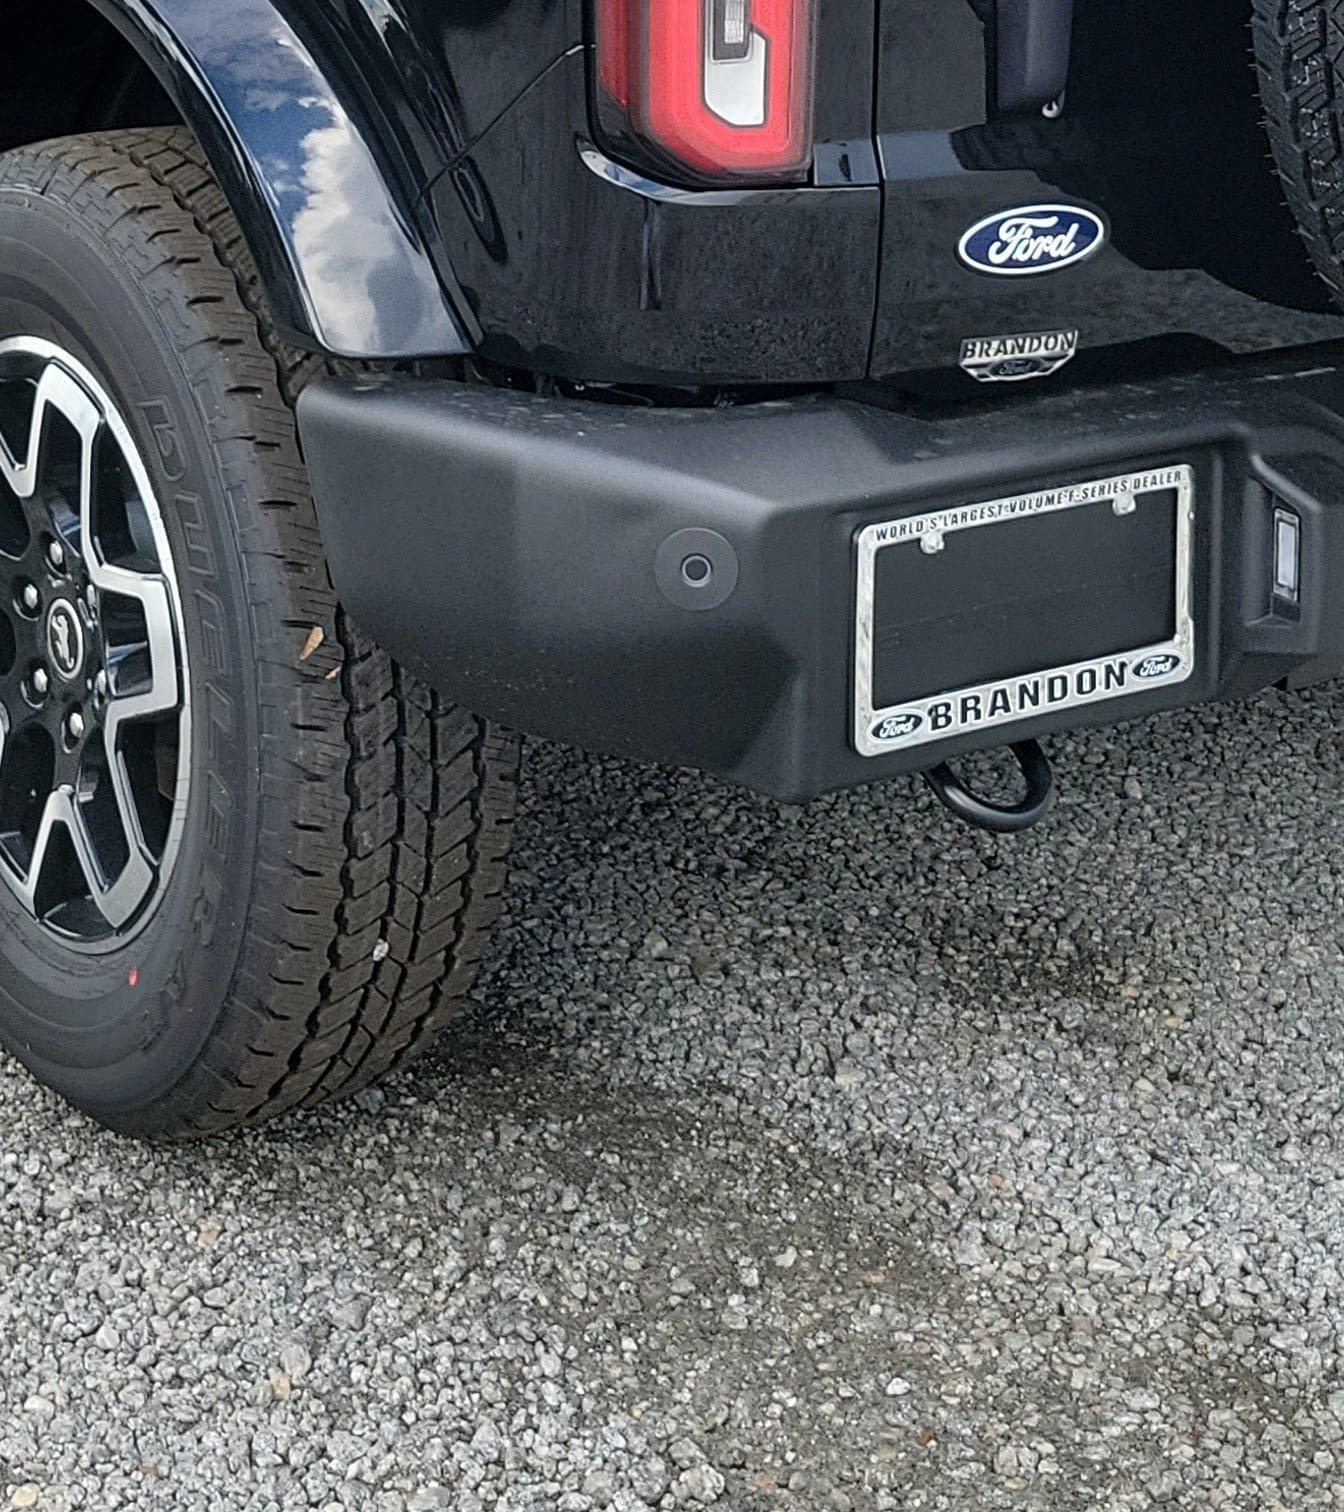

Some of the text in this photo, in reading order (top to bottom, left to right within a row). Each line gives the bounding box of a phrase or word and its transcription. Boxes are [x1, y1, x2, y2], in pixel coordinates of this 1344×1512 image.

[987, 215, 1080, 265] Ford
[961, 330, 1076, 360] BRANDON
[943, 504, 1003, 528] LARGEST
[1009, 493, 1063, 514] VOLUME
[1068, 479, 1129, 503] F-SERIES
[1132, 470, 1182, 490] DEALER
[878, 654, 1177, 739] Ford BRANDON Ford
